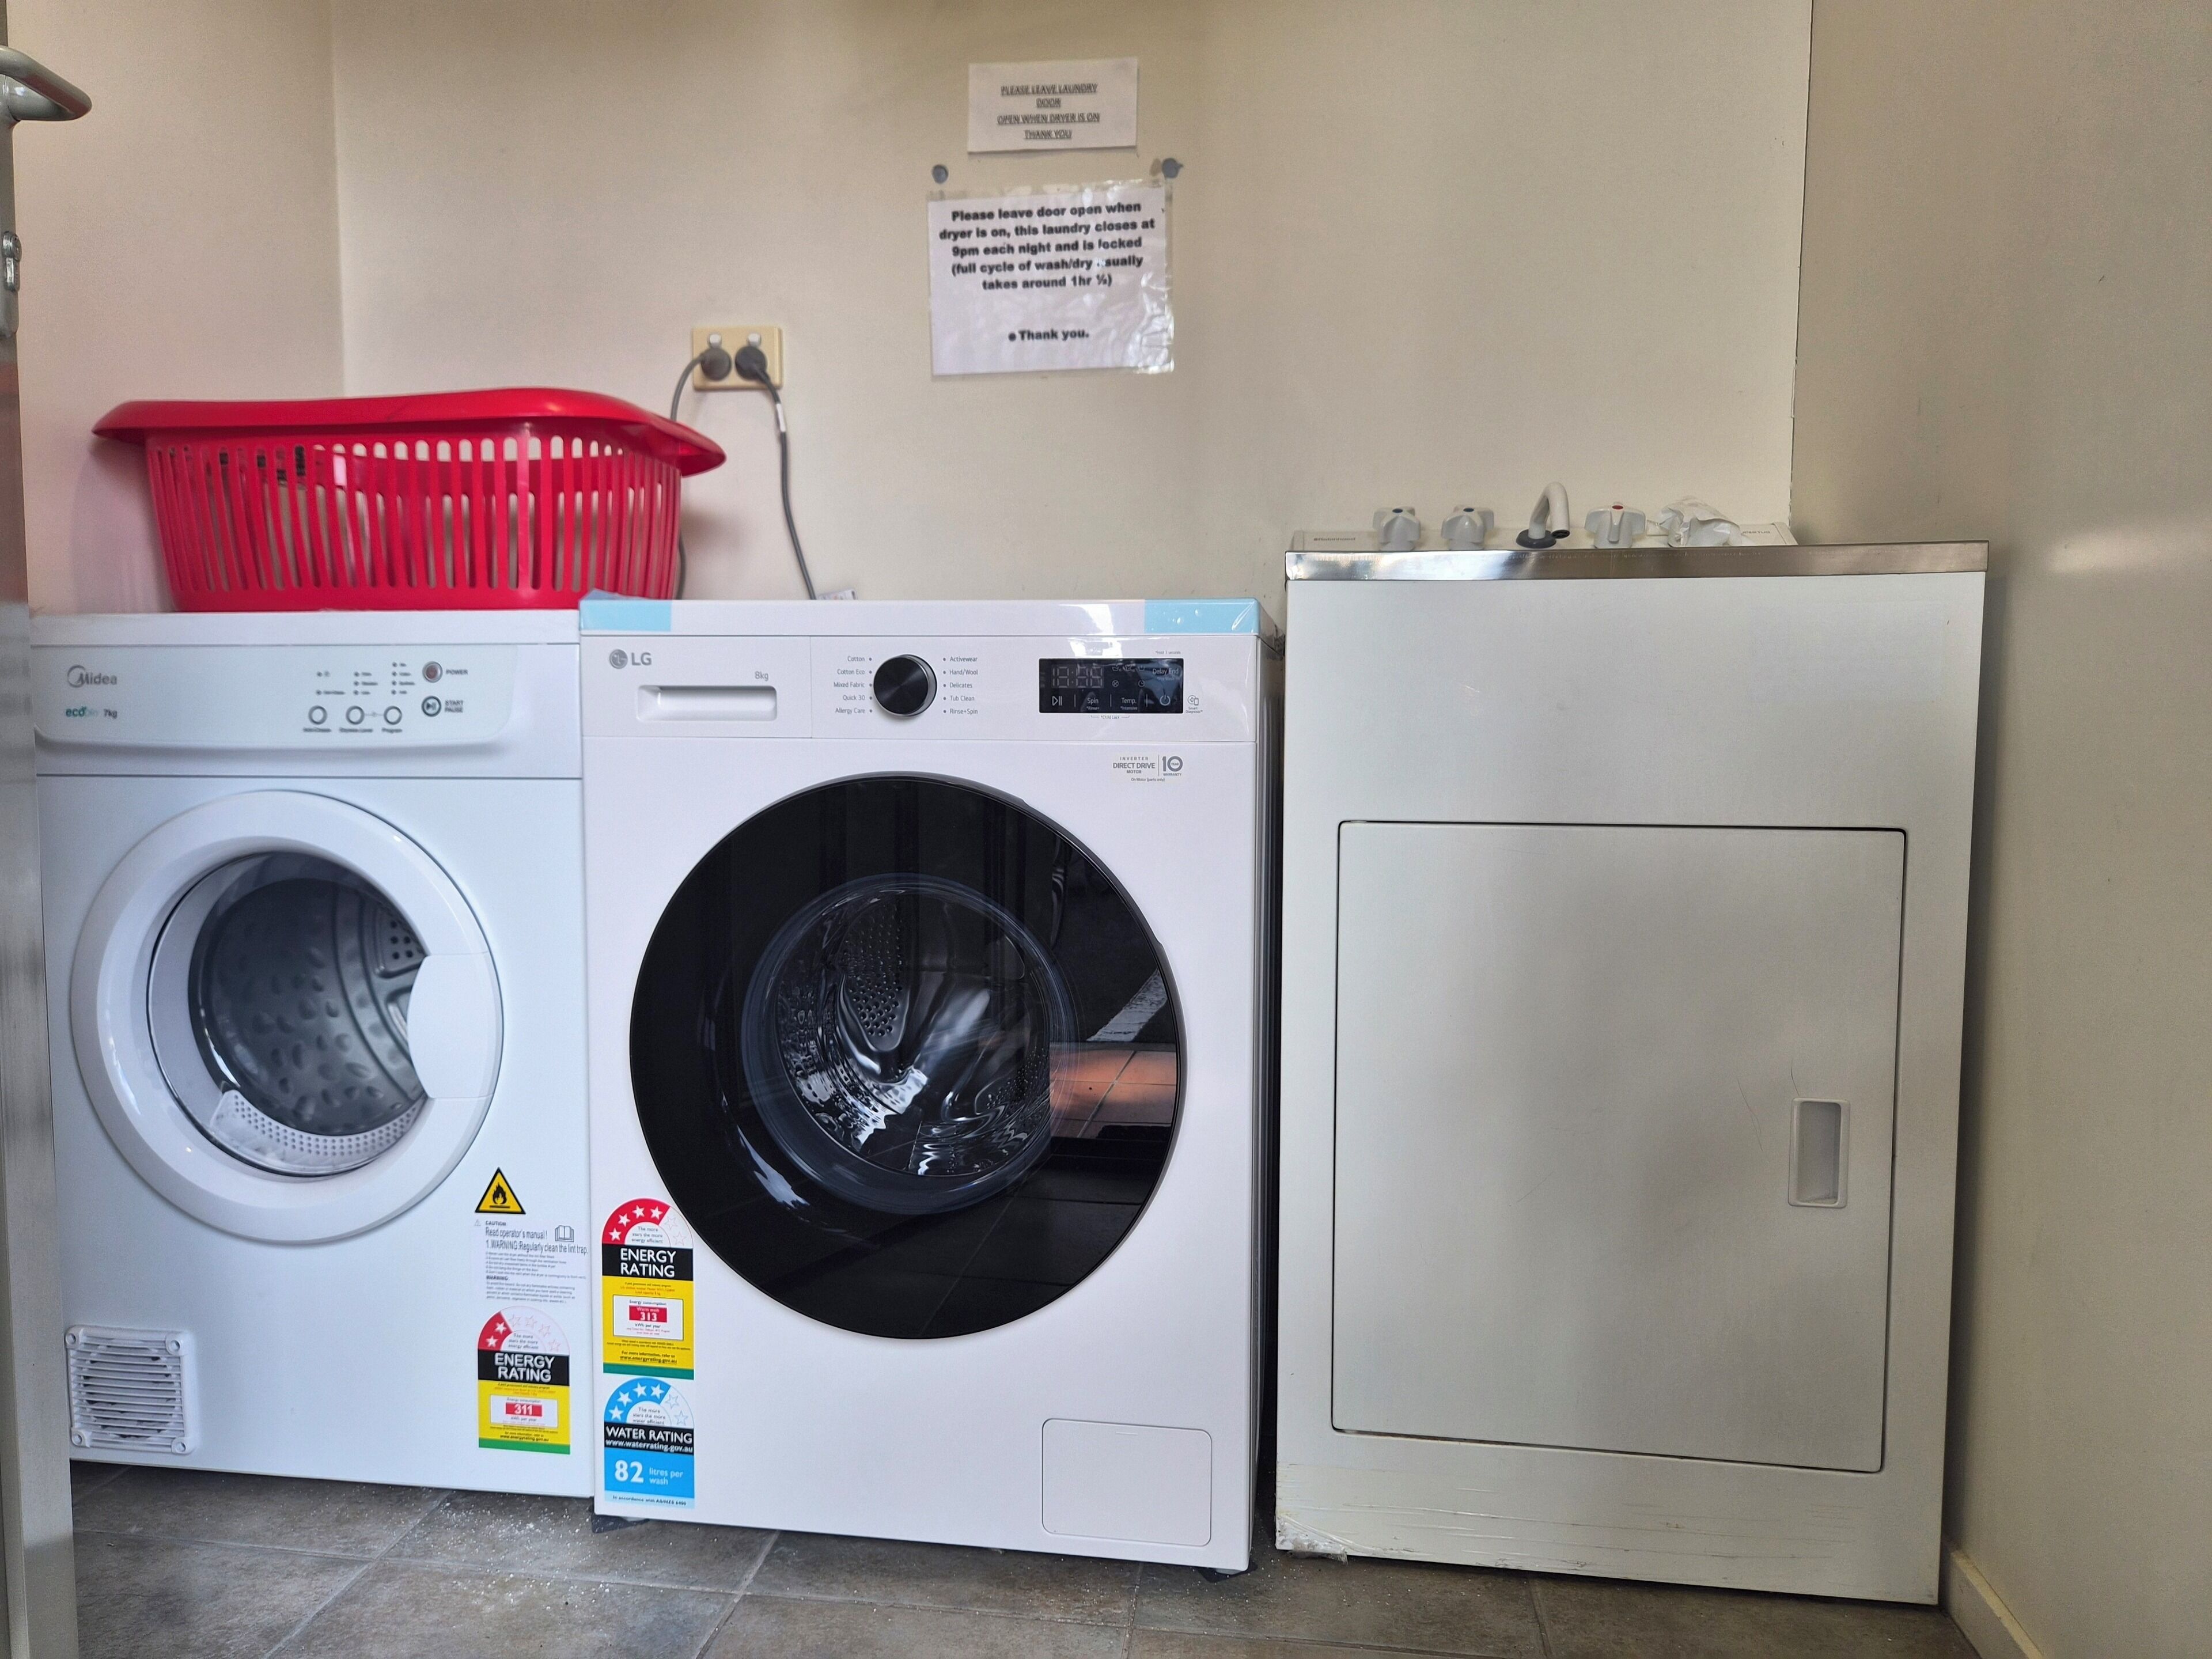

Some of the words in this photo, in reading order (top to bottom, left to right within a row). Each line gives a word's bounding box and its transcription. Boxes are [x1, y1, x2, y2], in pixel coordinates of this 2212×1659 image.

[1001, 85, 1029, 96] PLEASE
[1031, 85, 1056, 95] LEAVE
[1059, 83, 1098, 94] LAUNDRY
[1036, 97, 1061, 108] DOOR
[997, 115, 1020, 125] OPEN
[1022, 114, 1048, 124] WHEN
[1050, 113, 1075, 123] DRYER
[1077, 113, 1085, 122] IS
[1086, 112, 1100, 122] ON
[1024, 130, 1052, 139] THANK
[1054, 130, 1073, 139] YOU
[951, 209, 995, 221] Please
[998, 209, 1033, 219] leave
[1036, 206, 1066, 217] door
[1070, 206, 1102, 217] open
[1105, 203, 1141, 214] when
[939, 229, 973, 241] dryer
[975, 228, 987, 237] is
[991, 228, 1011, 239] on,
[1014, 225, 1039, 236] this
[1042, 223, 1090, 234] laundry
[1094, 221, 1137, 232] closes
[1141, 218, 1155, 229] at
[951, 246, 979, 258] 9pm
[983, 244, 1015, 255] each
[1018, 243, 1051, 255] night
[1055, 240, 1079, 251] and
[1082, 240, 1094, 250] is
[1097, 237, 1142, 249] locked
[951, 263, 976, 277] (full
[979, 262, 1014, 274] cycle
[1018, 260, 1032, 271] of
[1035, 259, 1093, 271] wash/dry
[982, 278, 1018, 290] takes
[1021, 276, 1067, 287] around
[1070, 274, 1092, 286] 1hr
[1018, 329, 1058, 340] Thank
[1062, 329, 1089, 341] you.
[631, 652, 652, 666] LG
[70, 668, 118, 687] Midea
[754, 671, 769, 681] 8kg
[103, 709, 118, 718] 7kg
[1161, 756, 1183, 772] 10
[486, 1226, 499, 1236] Read
[526, 1230, 545, 1238] manual
[544, 1242, 558, 1252] clean
[559, 1243, 567, 1252] the
[568, 1244, 576, 1253] lint
[577, 1245, 589, 1255] trap.
[620, 1248, 676, 1263] ENERGY
[620, 1263, 675, 1278] RATING
[640, 1312, 657, 1321] 313
[494, 1353, 555, 1369] ENERGY
[620, 1355, 677, 1364] www.energyrating.gov.au
[498, 1366, 551, 1382] RATING
[514, 1404, 533, 1415] 311
[605, 1426, 646, 1440] WATER
[649, 1429, 692, 1444] RATING
[605, 1439, 693, 1453] www.waterrating.gov.au
[615, 1460, 644, 1483] 82
[649, 1467, 668, 1476] litres
[670, 1471, 683, 1479] per
